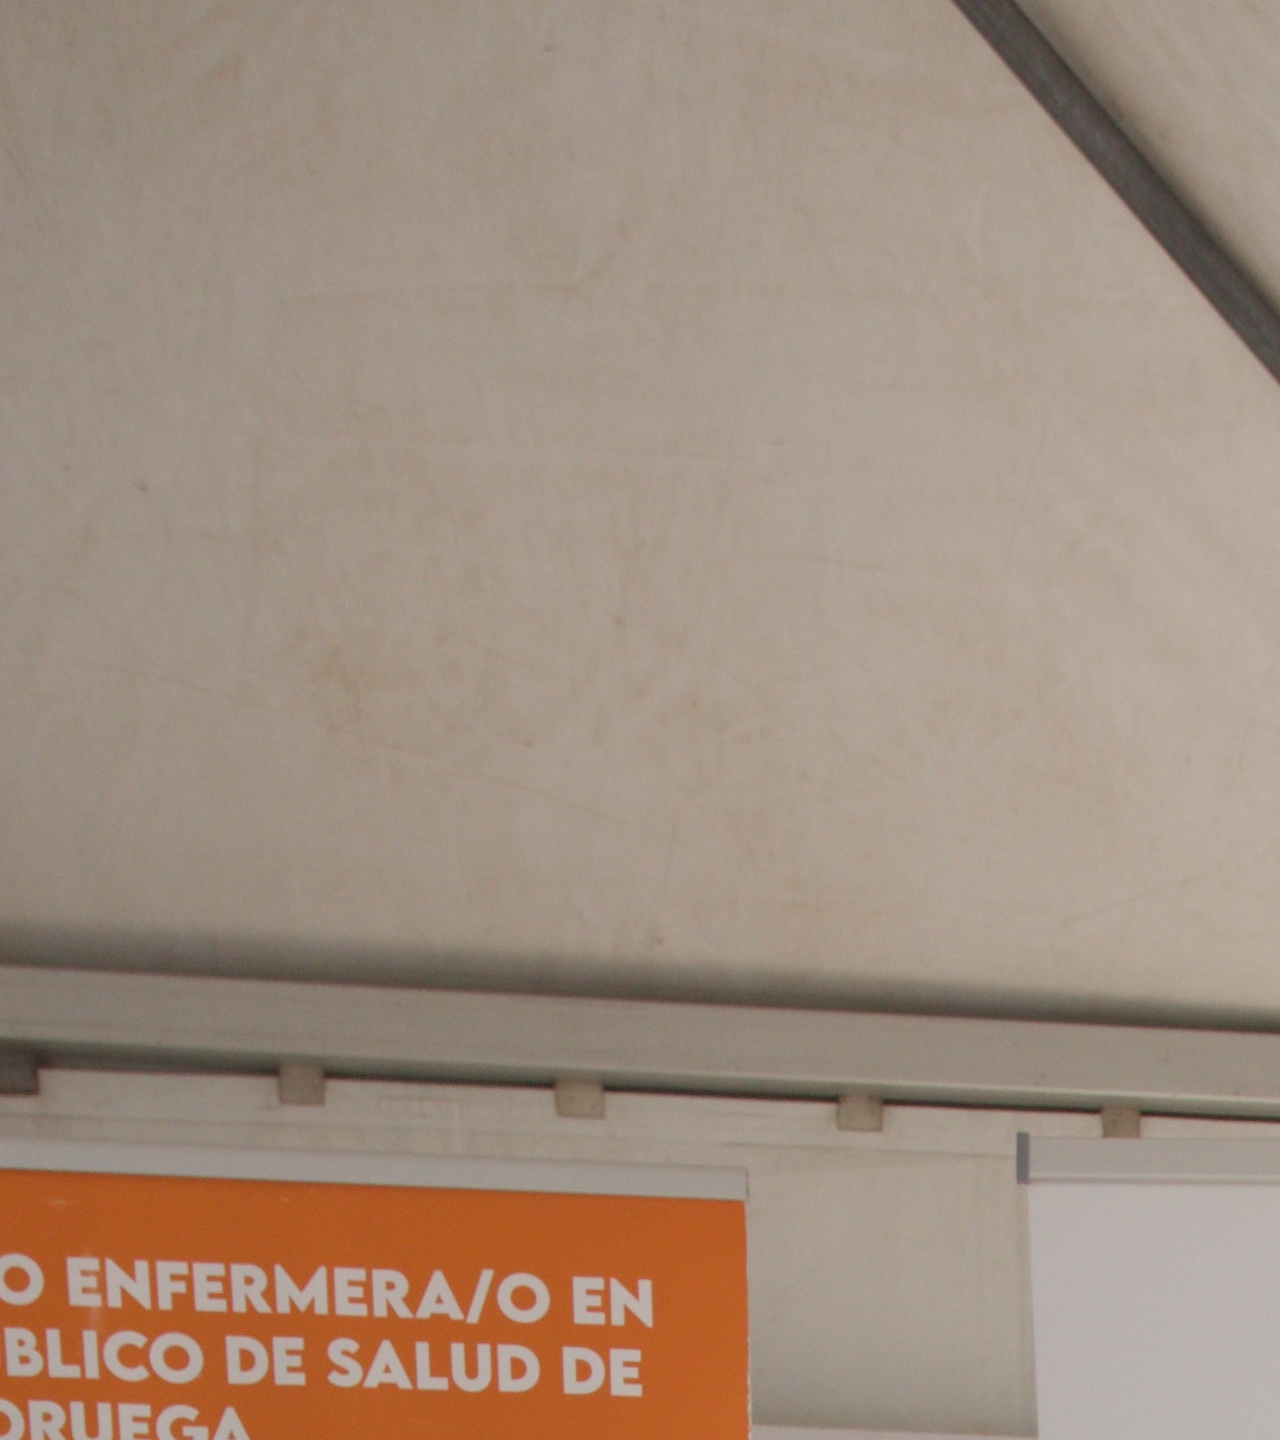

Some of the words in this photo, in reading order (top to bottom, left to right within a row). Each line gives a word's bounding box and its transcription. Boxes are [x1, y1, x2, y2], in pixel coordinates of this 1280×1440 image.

[67, 1256, 551, 1325] ENFERMERA/O
[572, 1276, 654, 1329] EN
[0, 1326, 204, 1384] BLICO
[225, 1335, 306, 1387] DE
[327, 1339, 540, 1393] SALUD
[563, 1346, 644, 1398] DE
